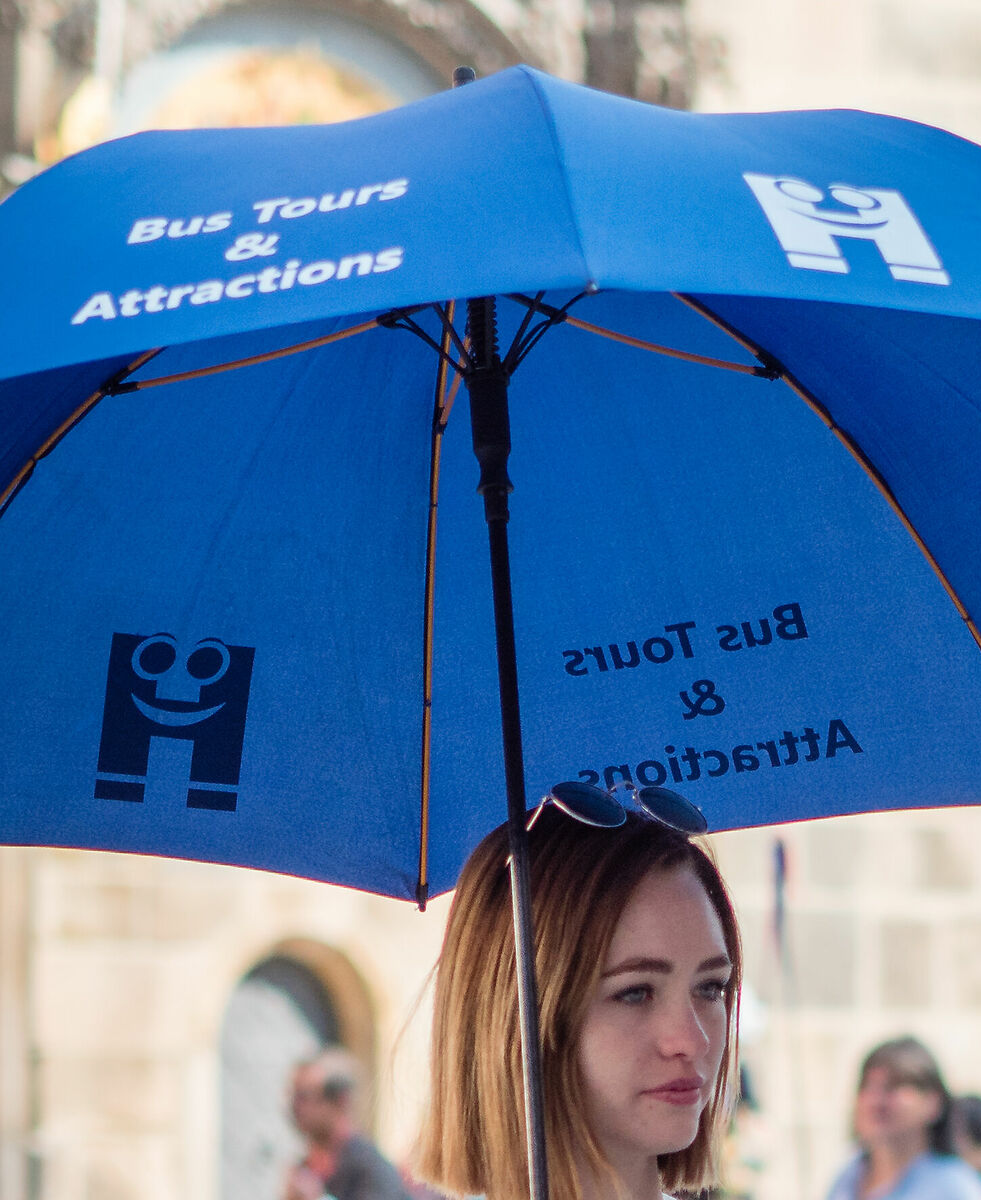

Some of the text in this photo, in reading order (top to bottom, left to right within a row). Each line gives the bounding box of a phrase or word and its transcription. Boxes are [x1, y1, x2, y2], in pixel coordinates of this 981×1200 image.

[127, 178, 409, 245] Bus Tours
[224, 231, 281, 262] &
[71, 246, 404, 325] Attractions
